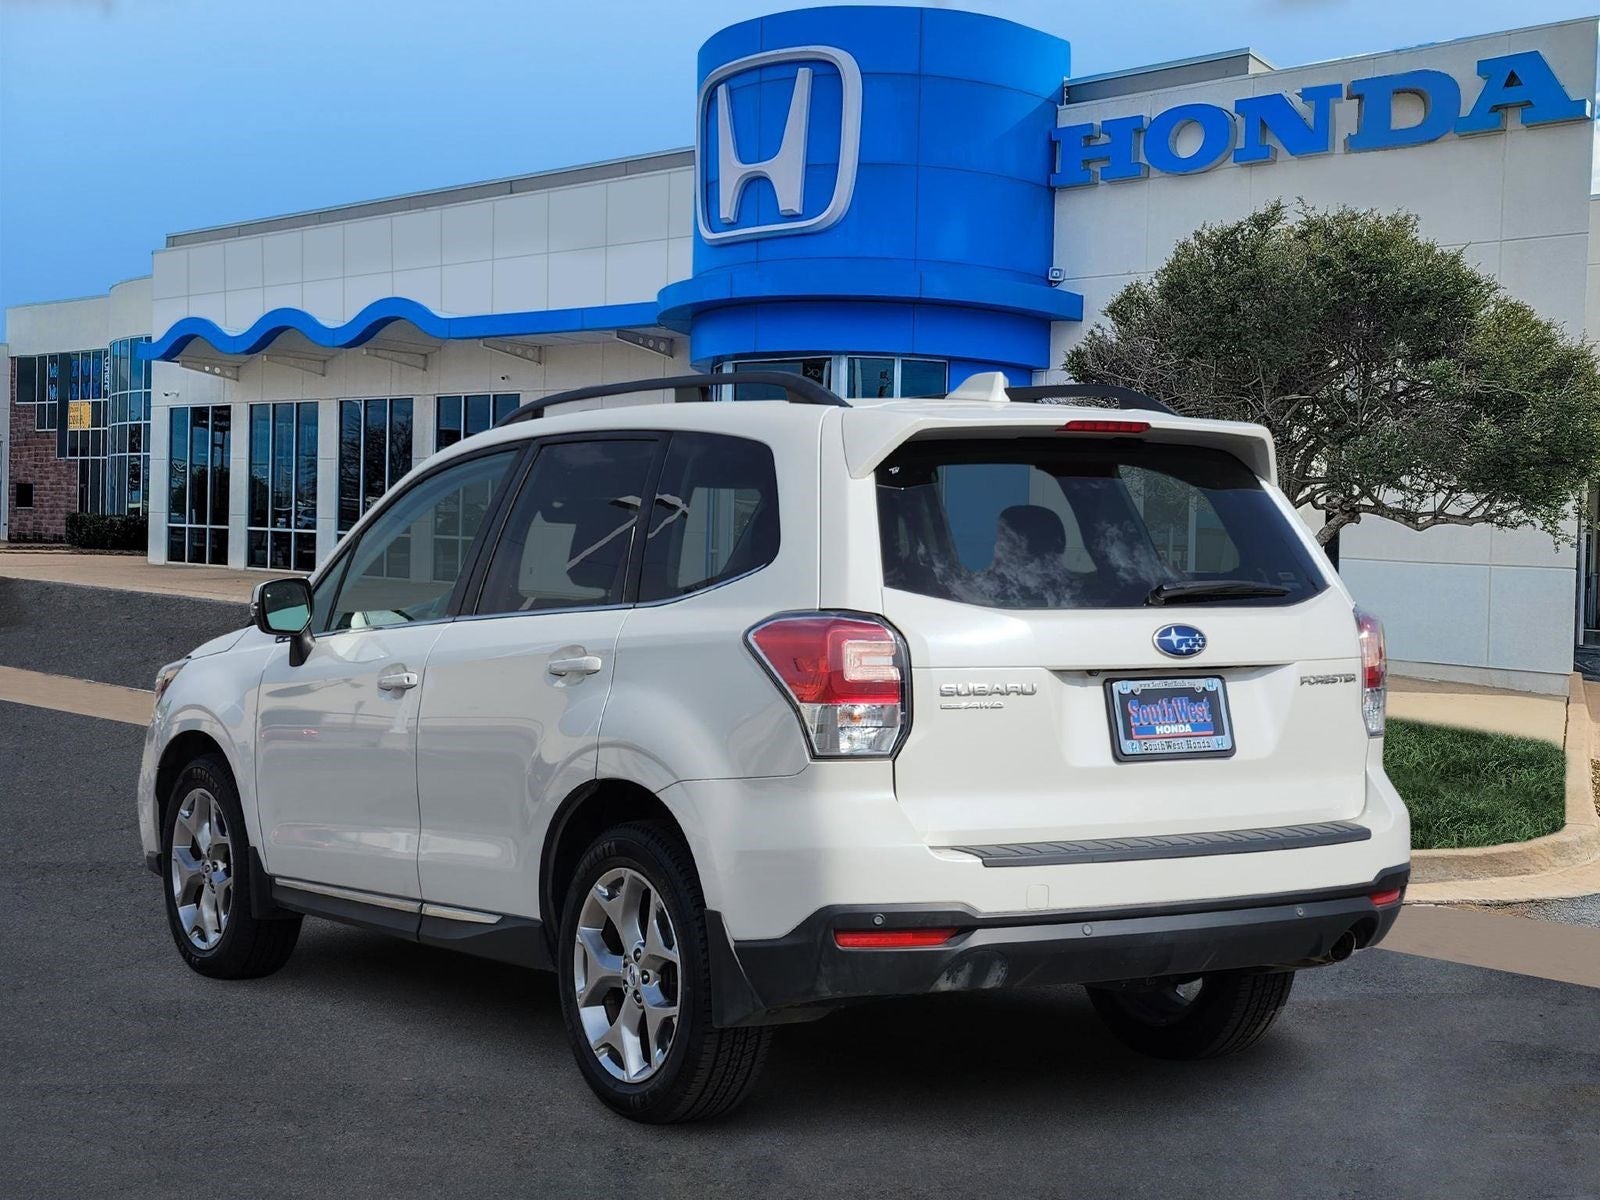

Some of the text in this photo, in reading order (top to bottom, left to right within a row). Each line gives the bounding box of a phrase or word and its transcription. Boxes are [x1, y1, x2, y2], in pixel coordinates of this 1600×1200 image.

[1050, 50, 1591, 188] HONDA
[1300, 673, 1357, 686] FORESTER
[939, 682, 1037, 697] SUBARU
[1128, 696, 1212, 725] SouthWest
[1155, 724, 1192, 734] HONDA
[1143, 739, 1211, 751] SouthWest Honda
